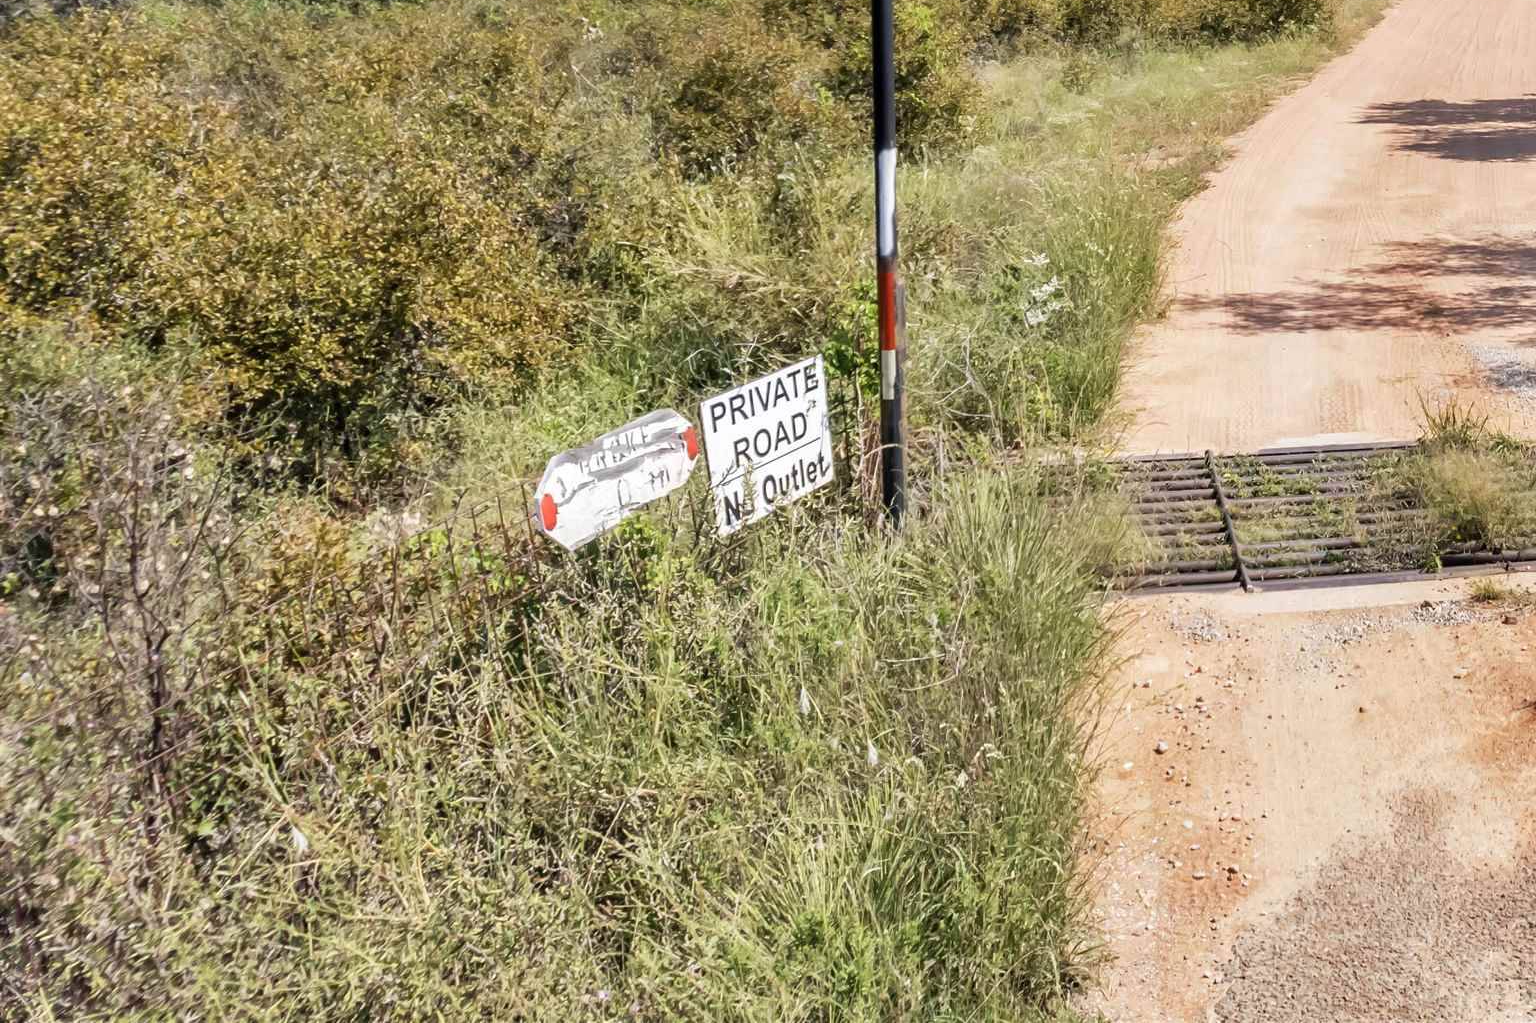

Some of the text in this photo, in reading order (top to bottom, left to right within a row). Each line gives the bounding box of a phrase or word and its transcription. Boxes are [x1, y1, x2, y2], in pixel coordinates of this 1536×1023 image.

[709, 363, 819, 433] PRIVATE
[733, 412, 808, 468] ROAD
[723, 450, 831, 526] N Outlet
